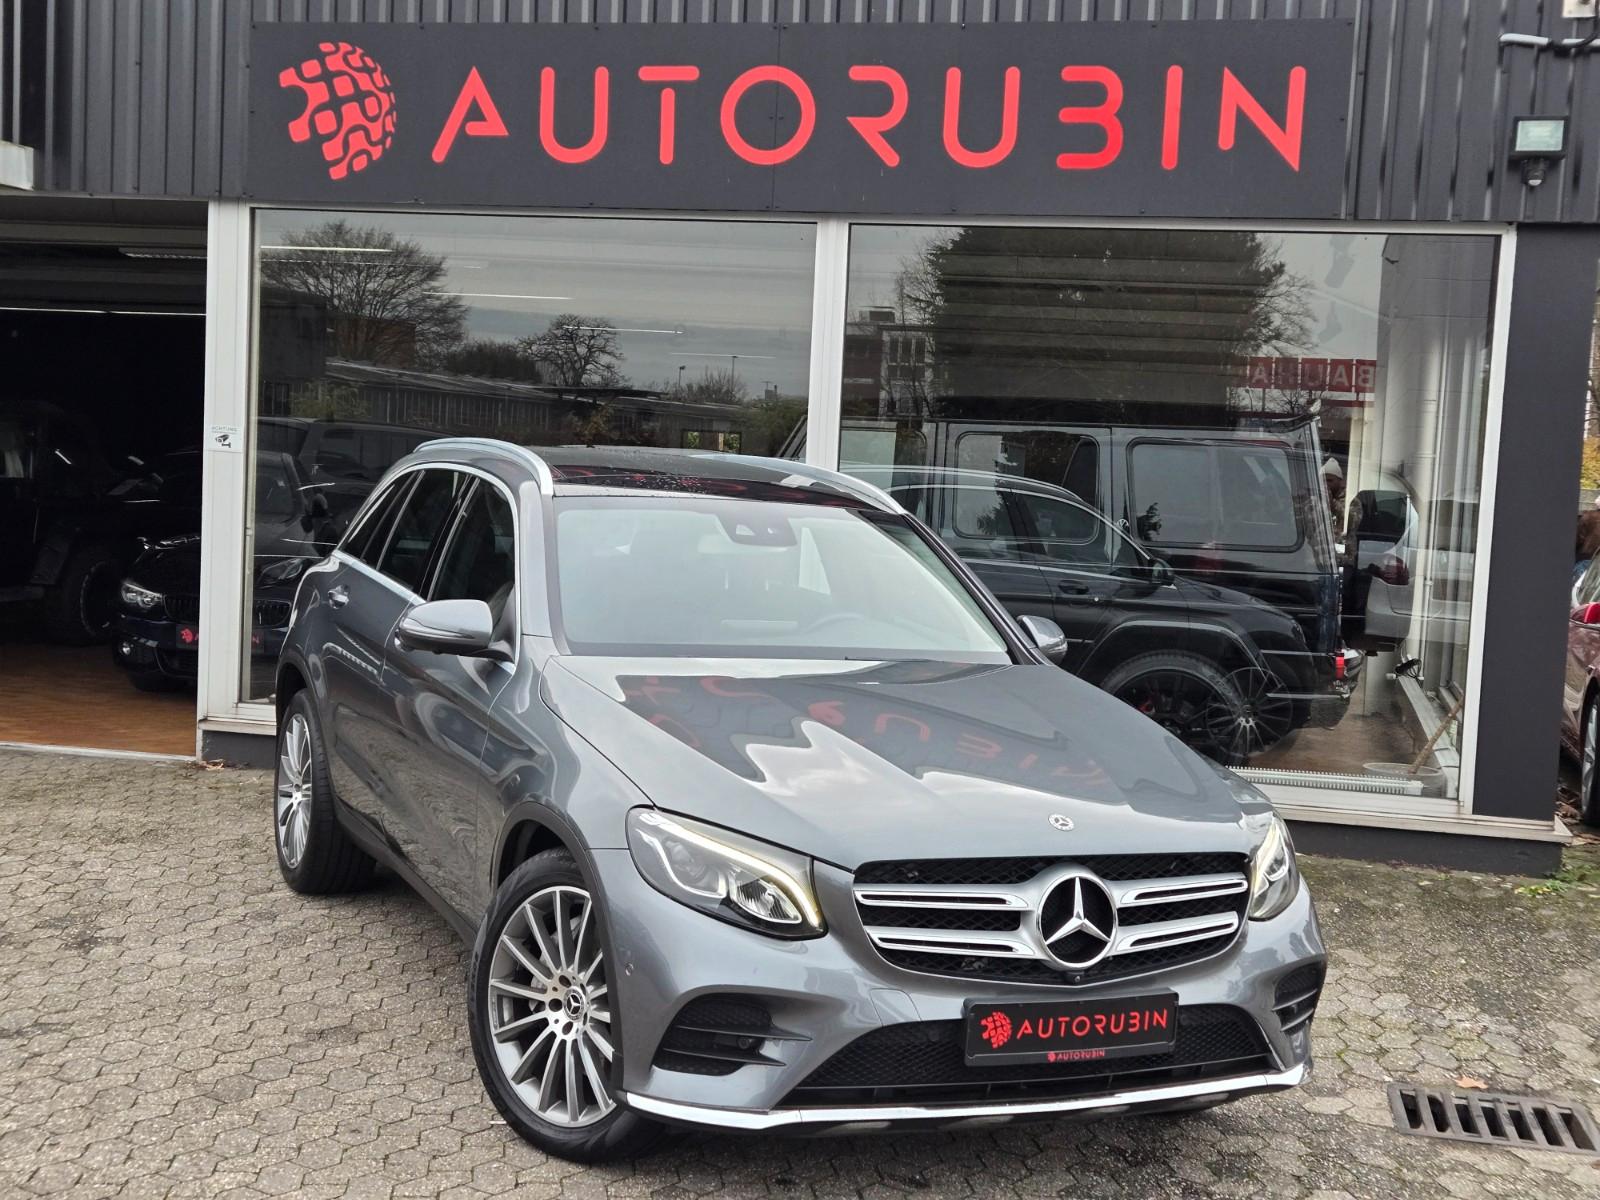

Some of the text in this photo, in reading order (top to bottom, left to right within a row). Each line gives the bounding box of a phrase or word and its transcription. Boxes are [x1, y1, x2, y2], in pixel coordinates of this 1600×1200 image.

[431, 64, 1307, 171] AUTORUBIN
[1016, 1008, 1168, 1040] AUTORUBIN
[1057, 1050, 1105, 1061] AUTORUBIN
